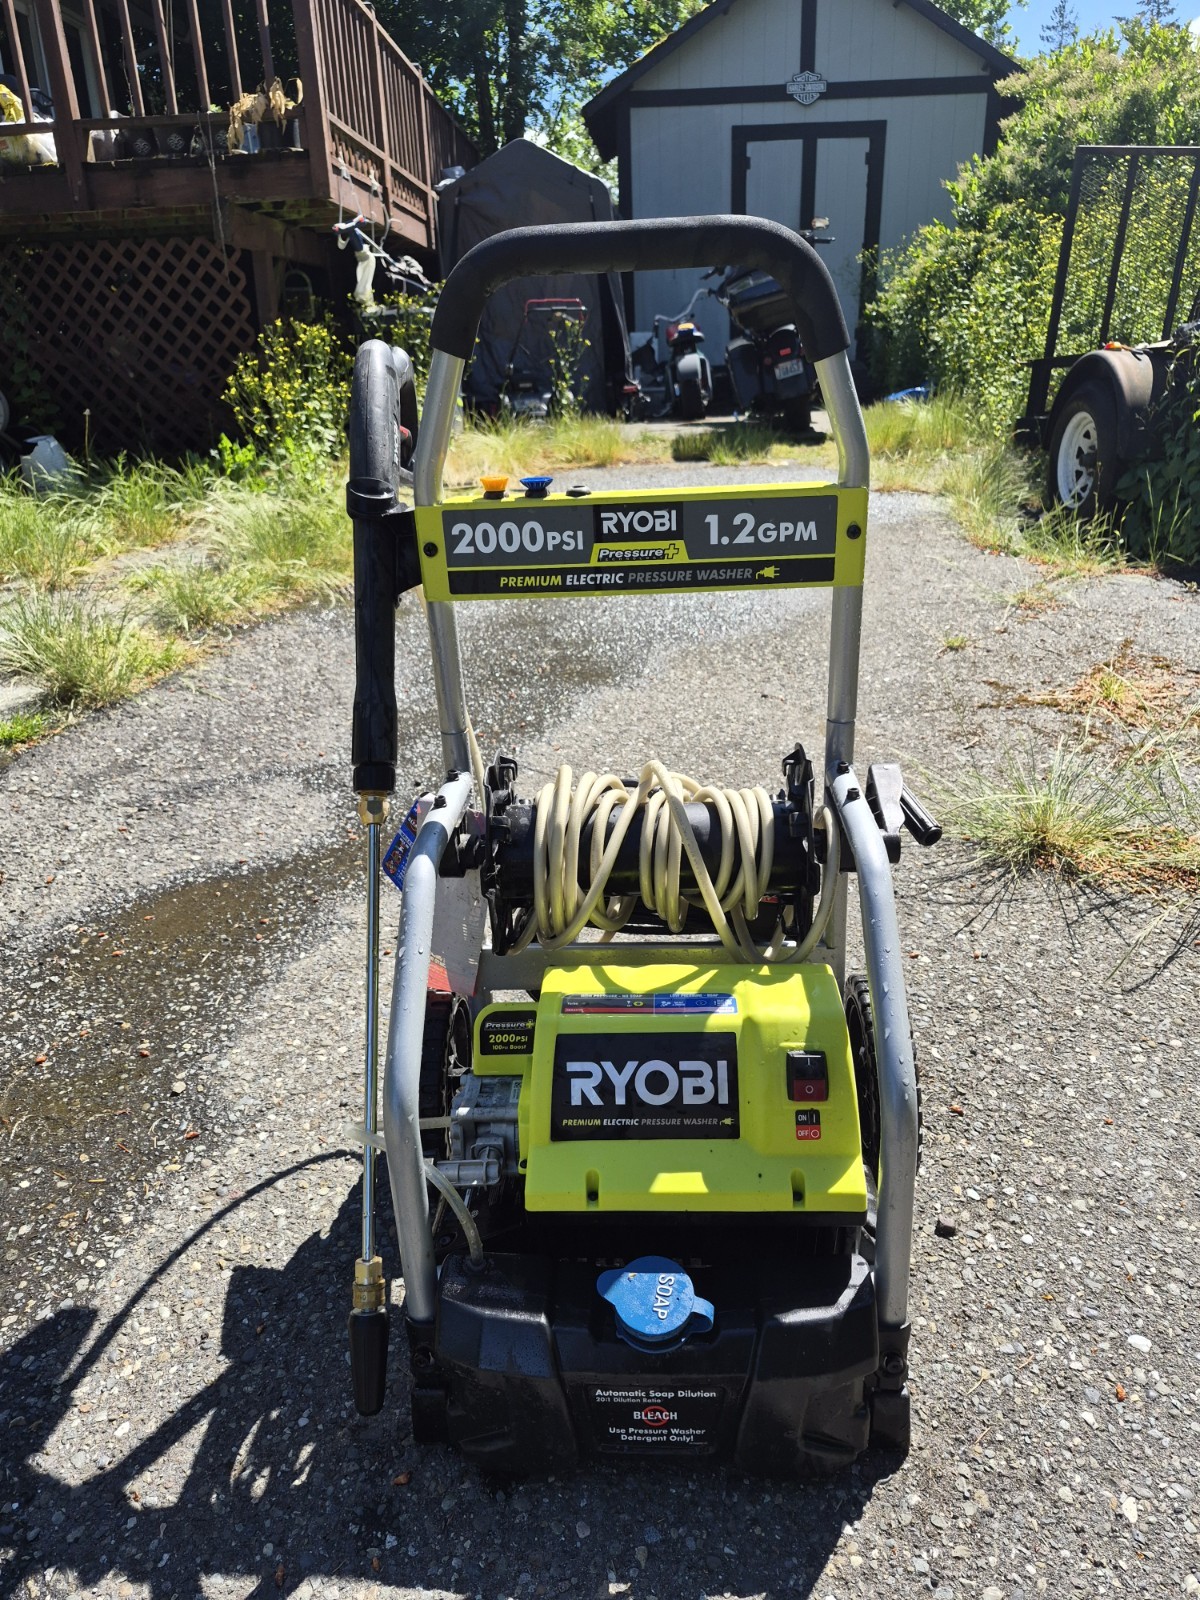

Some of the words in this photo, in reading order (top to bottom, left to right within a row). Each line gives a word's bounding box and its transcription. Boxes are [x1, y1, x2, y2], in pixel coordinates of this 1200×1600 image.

[600, 510, 677, 534] RYOBI
[500, 575, 562, 588] PREMIUM
[566, 573, 624, 586] ELECTRIC
[627, 570, 692, 584] PRESSURE
[696, 568, 753, 581] WASHER
[566, 1060, 729, 1106] RYOBI
[603, 1118, 639, 1126] ELECTRIC
[653, 1274, 675, 1320] SOAP
[595, 1389, 646, 1397] Automatic
[649, 1390, 675, 1399] Soap
[678, 1390, 717, 1398] Dilution
[633, 1411, 678, 1420] BLEACH
[628, 1427, 668, 1435] Pressure
[621, 1434, 667, 1442] Detergent
[669, 1435, 694, 1443] Only!
